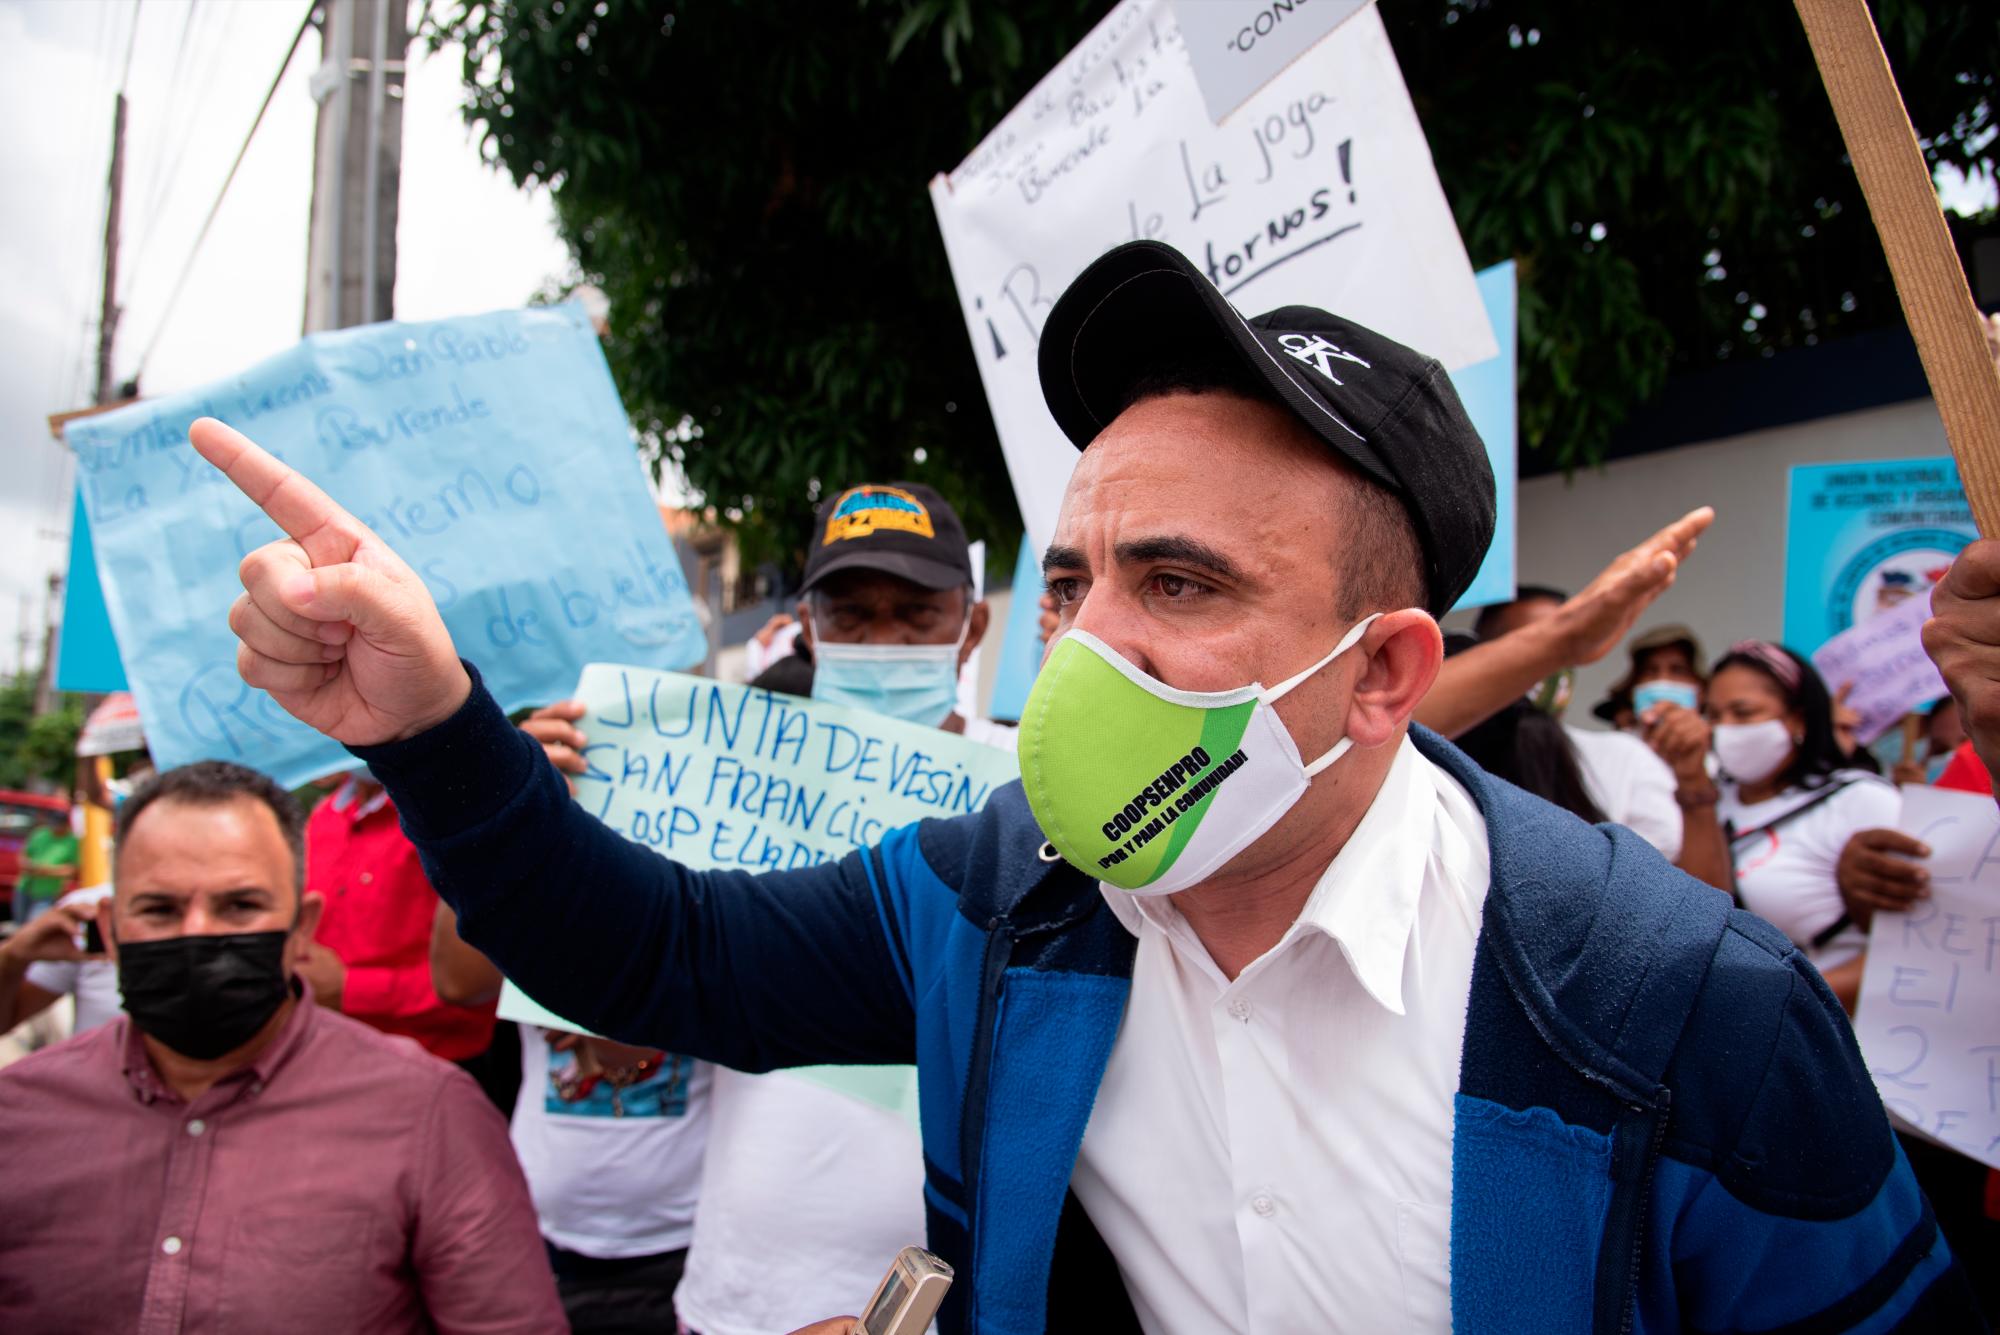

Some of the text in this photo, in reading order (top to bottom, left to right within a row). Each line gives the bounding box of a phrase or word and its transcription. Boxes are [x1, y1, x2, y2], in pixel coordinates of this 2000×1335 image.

[1102, 746, 1212, 843] COOPSENPRO
[1125, 840, 1137, 854] Y
[1132, 817, 1167, 848] PARA
[1160, 805, 1181, 826] LA
[1175, 749, 1249, 813] COMUNIDAD!
